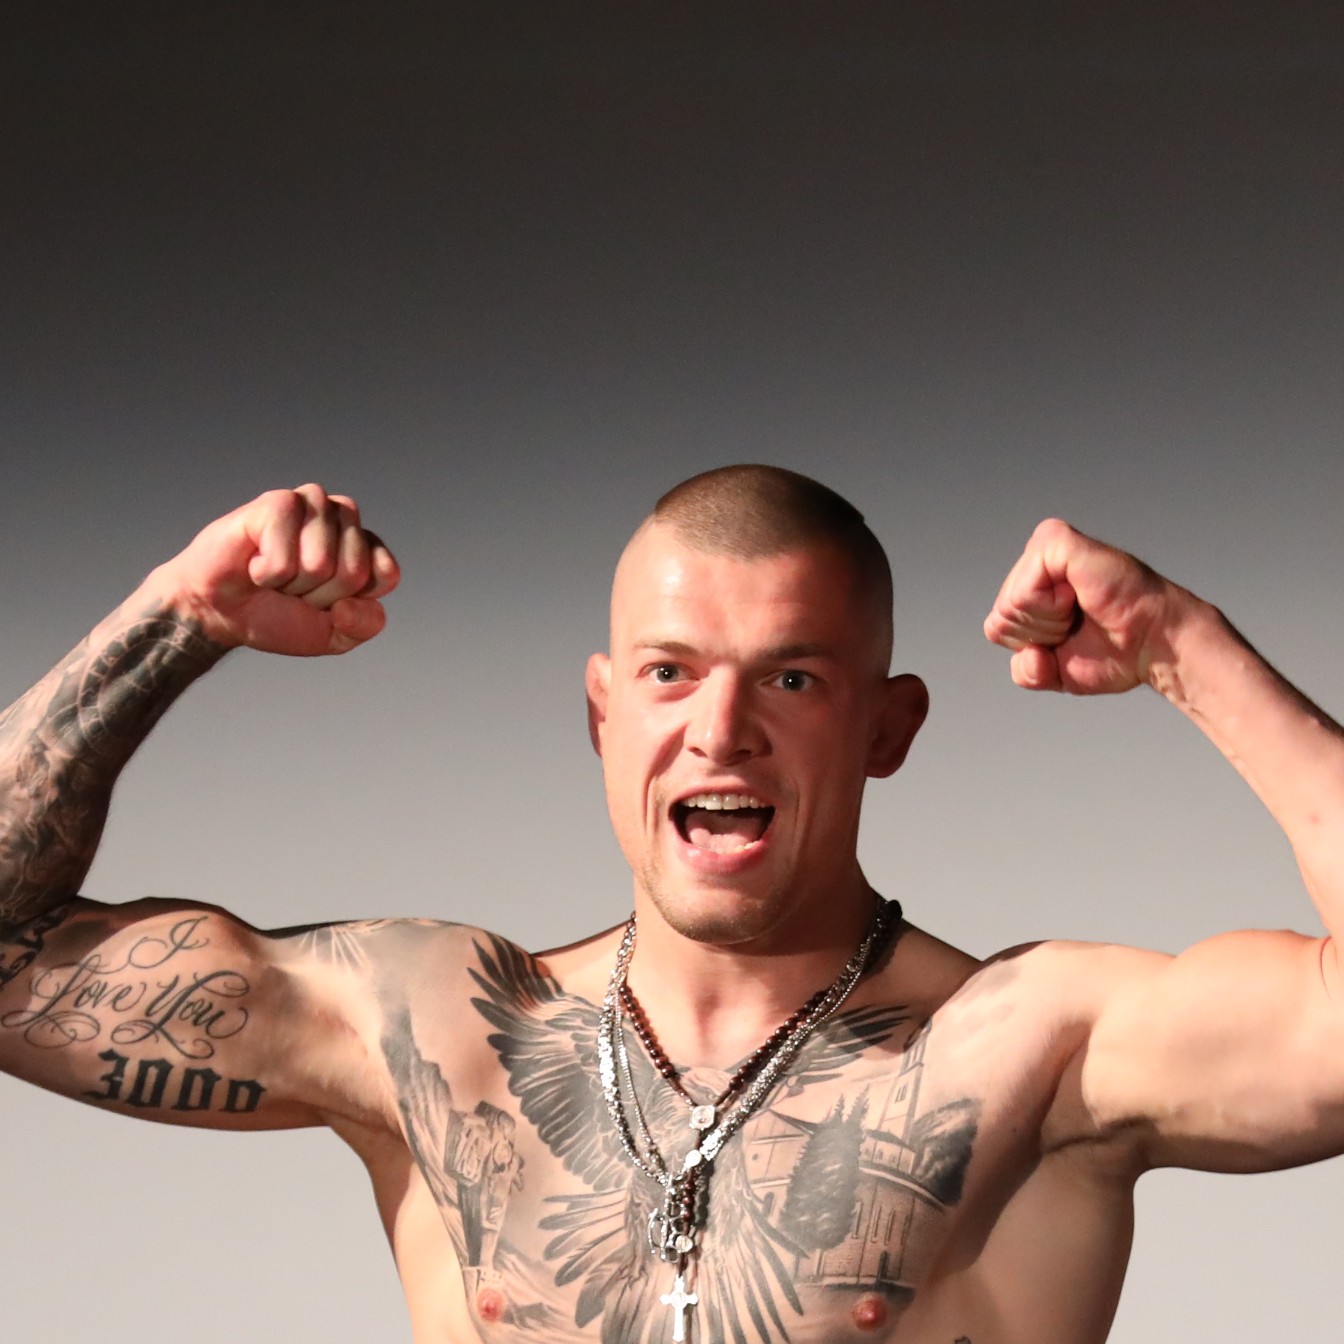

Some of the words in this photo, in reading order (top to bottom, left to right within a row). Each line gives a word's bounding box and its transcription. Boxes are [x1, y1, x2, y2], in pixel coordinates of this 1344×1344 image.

[1, 954, 146, 1047] Love
[111, 970, 249, 1059] You
[84, 1049, 266, 1114] 3000
